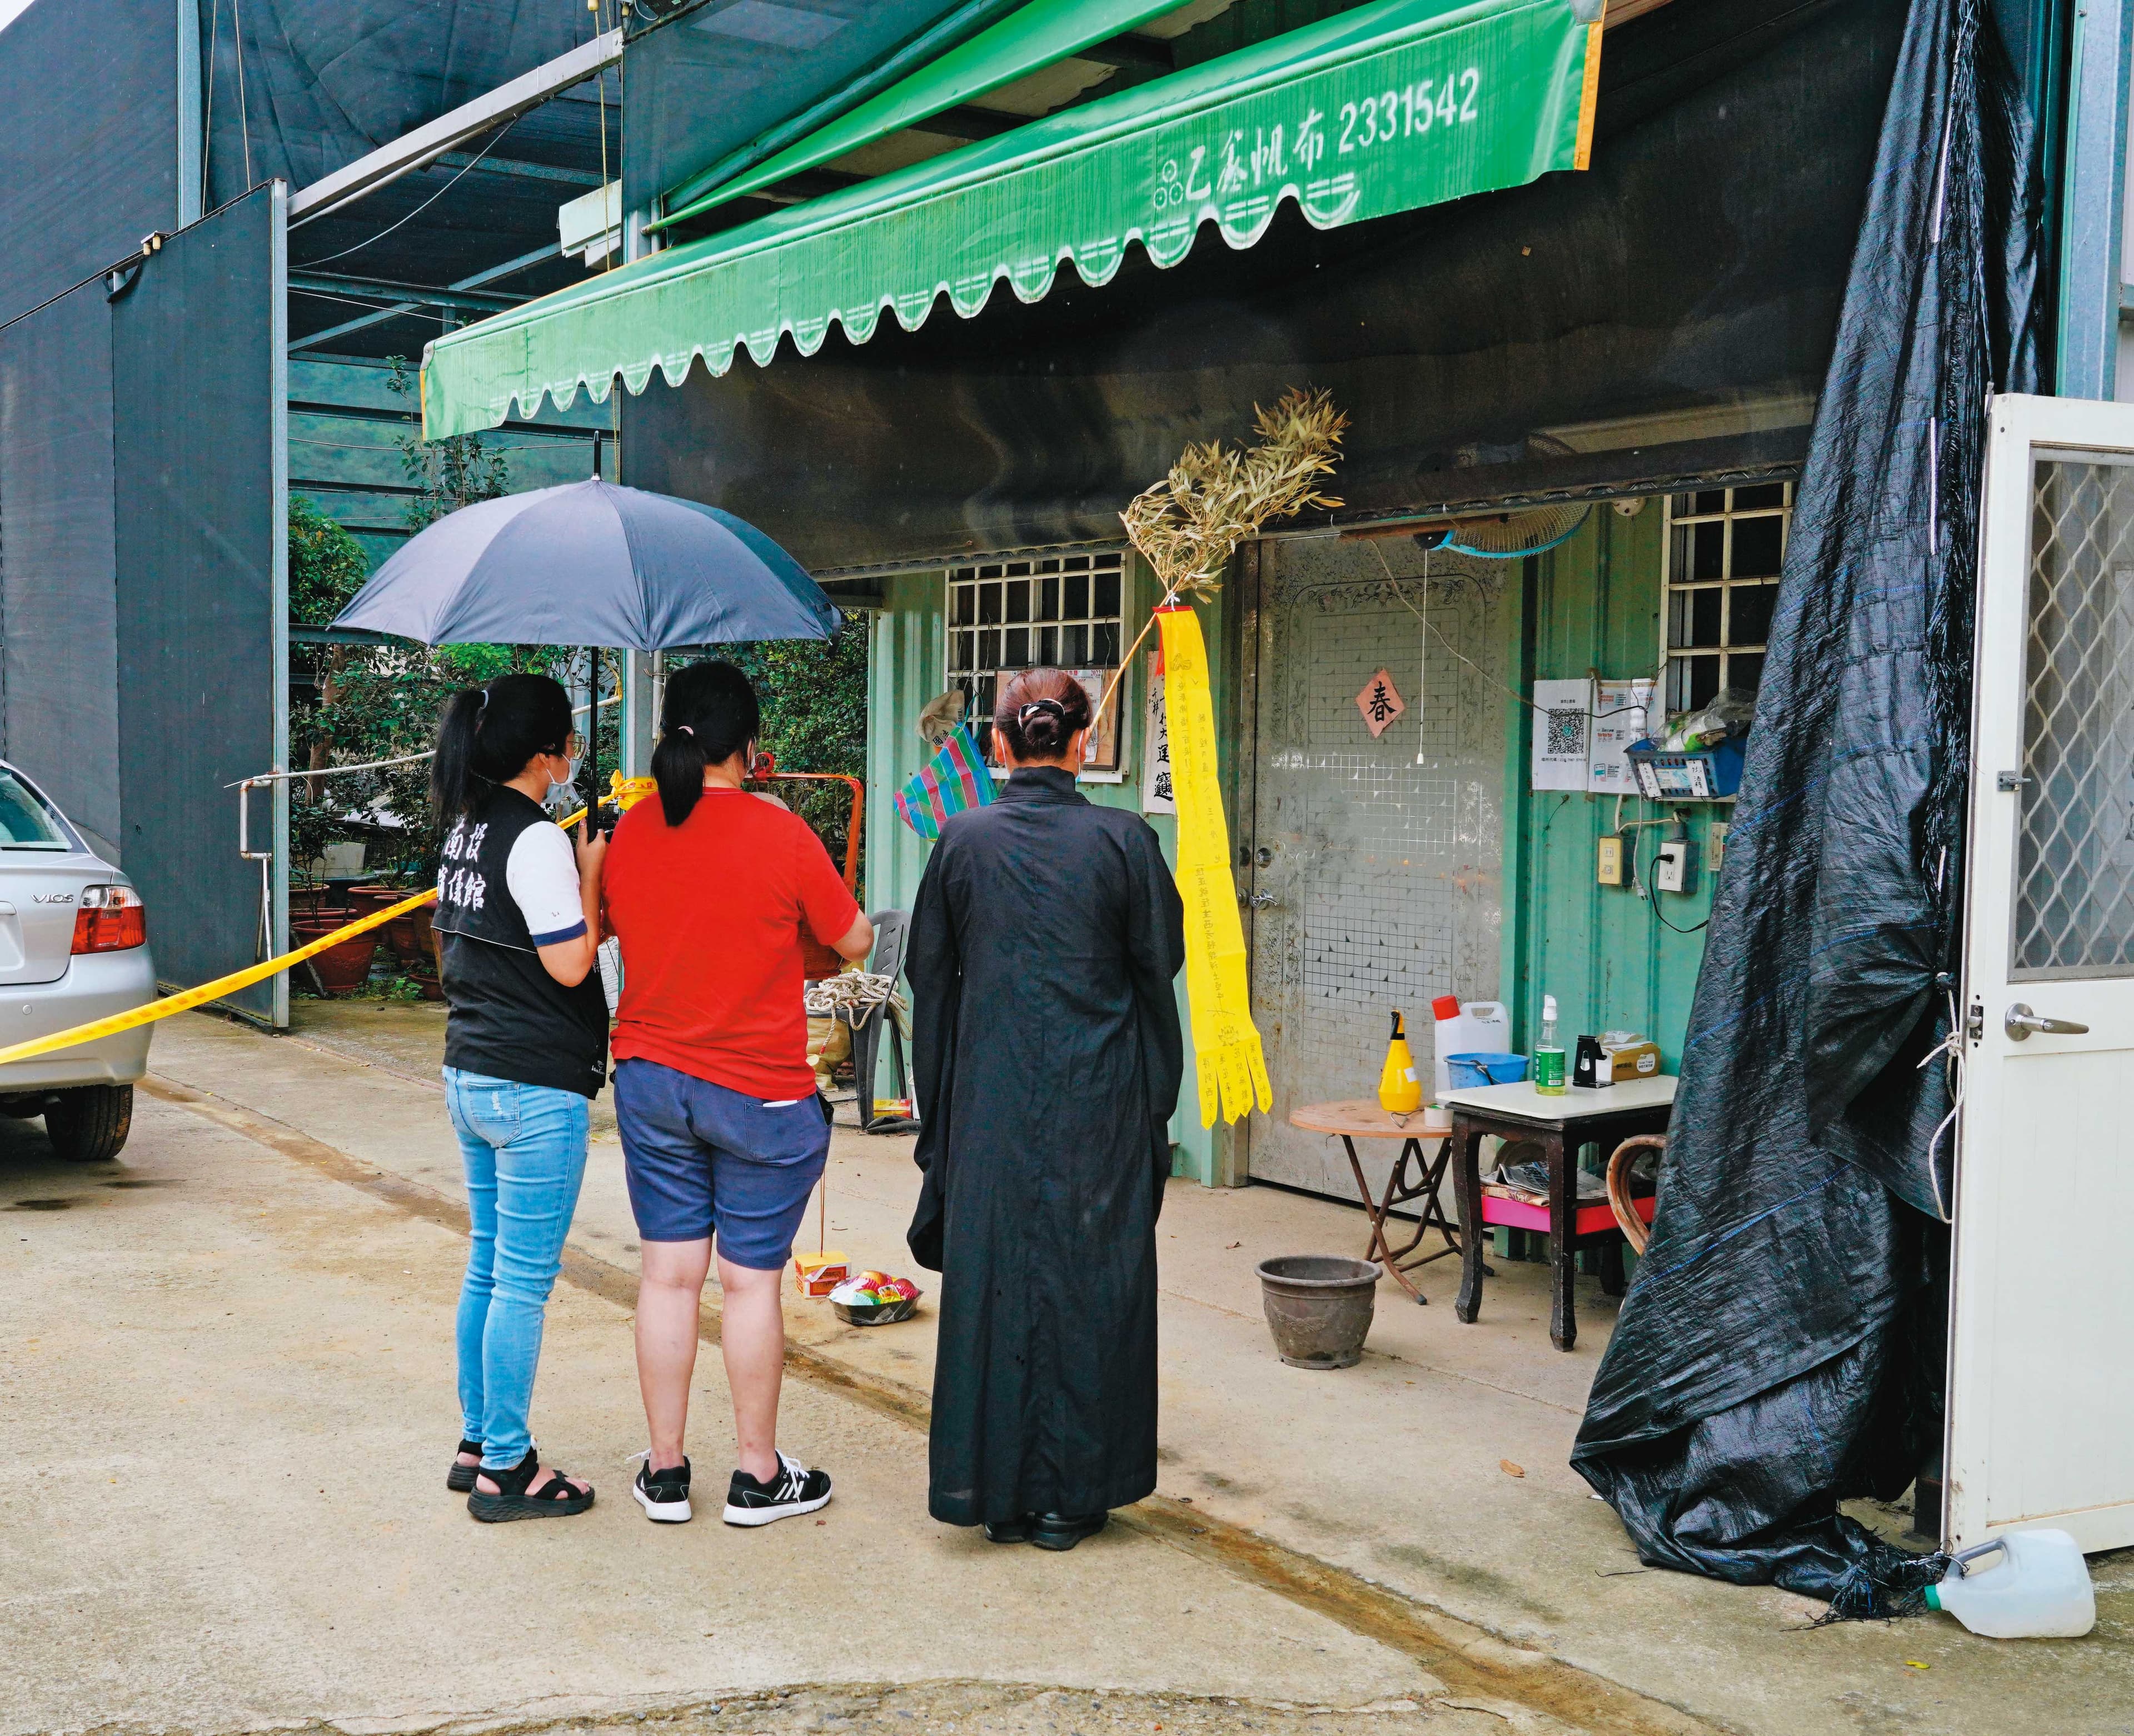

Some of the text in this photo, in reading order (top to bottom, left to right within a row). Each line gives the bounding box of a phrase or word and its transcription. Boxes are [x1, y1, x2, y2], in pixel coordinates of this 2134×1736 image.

[1338, 67, 1480, 153] 2331542
[1367, 680, 1397, 722] 春
[31, 893, 74, 904] VIOS
